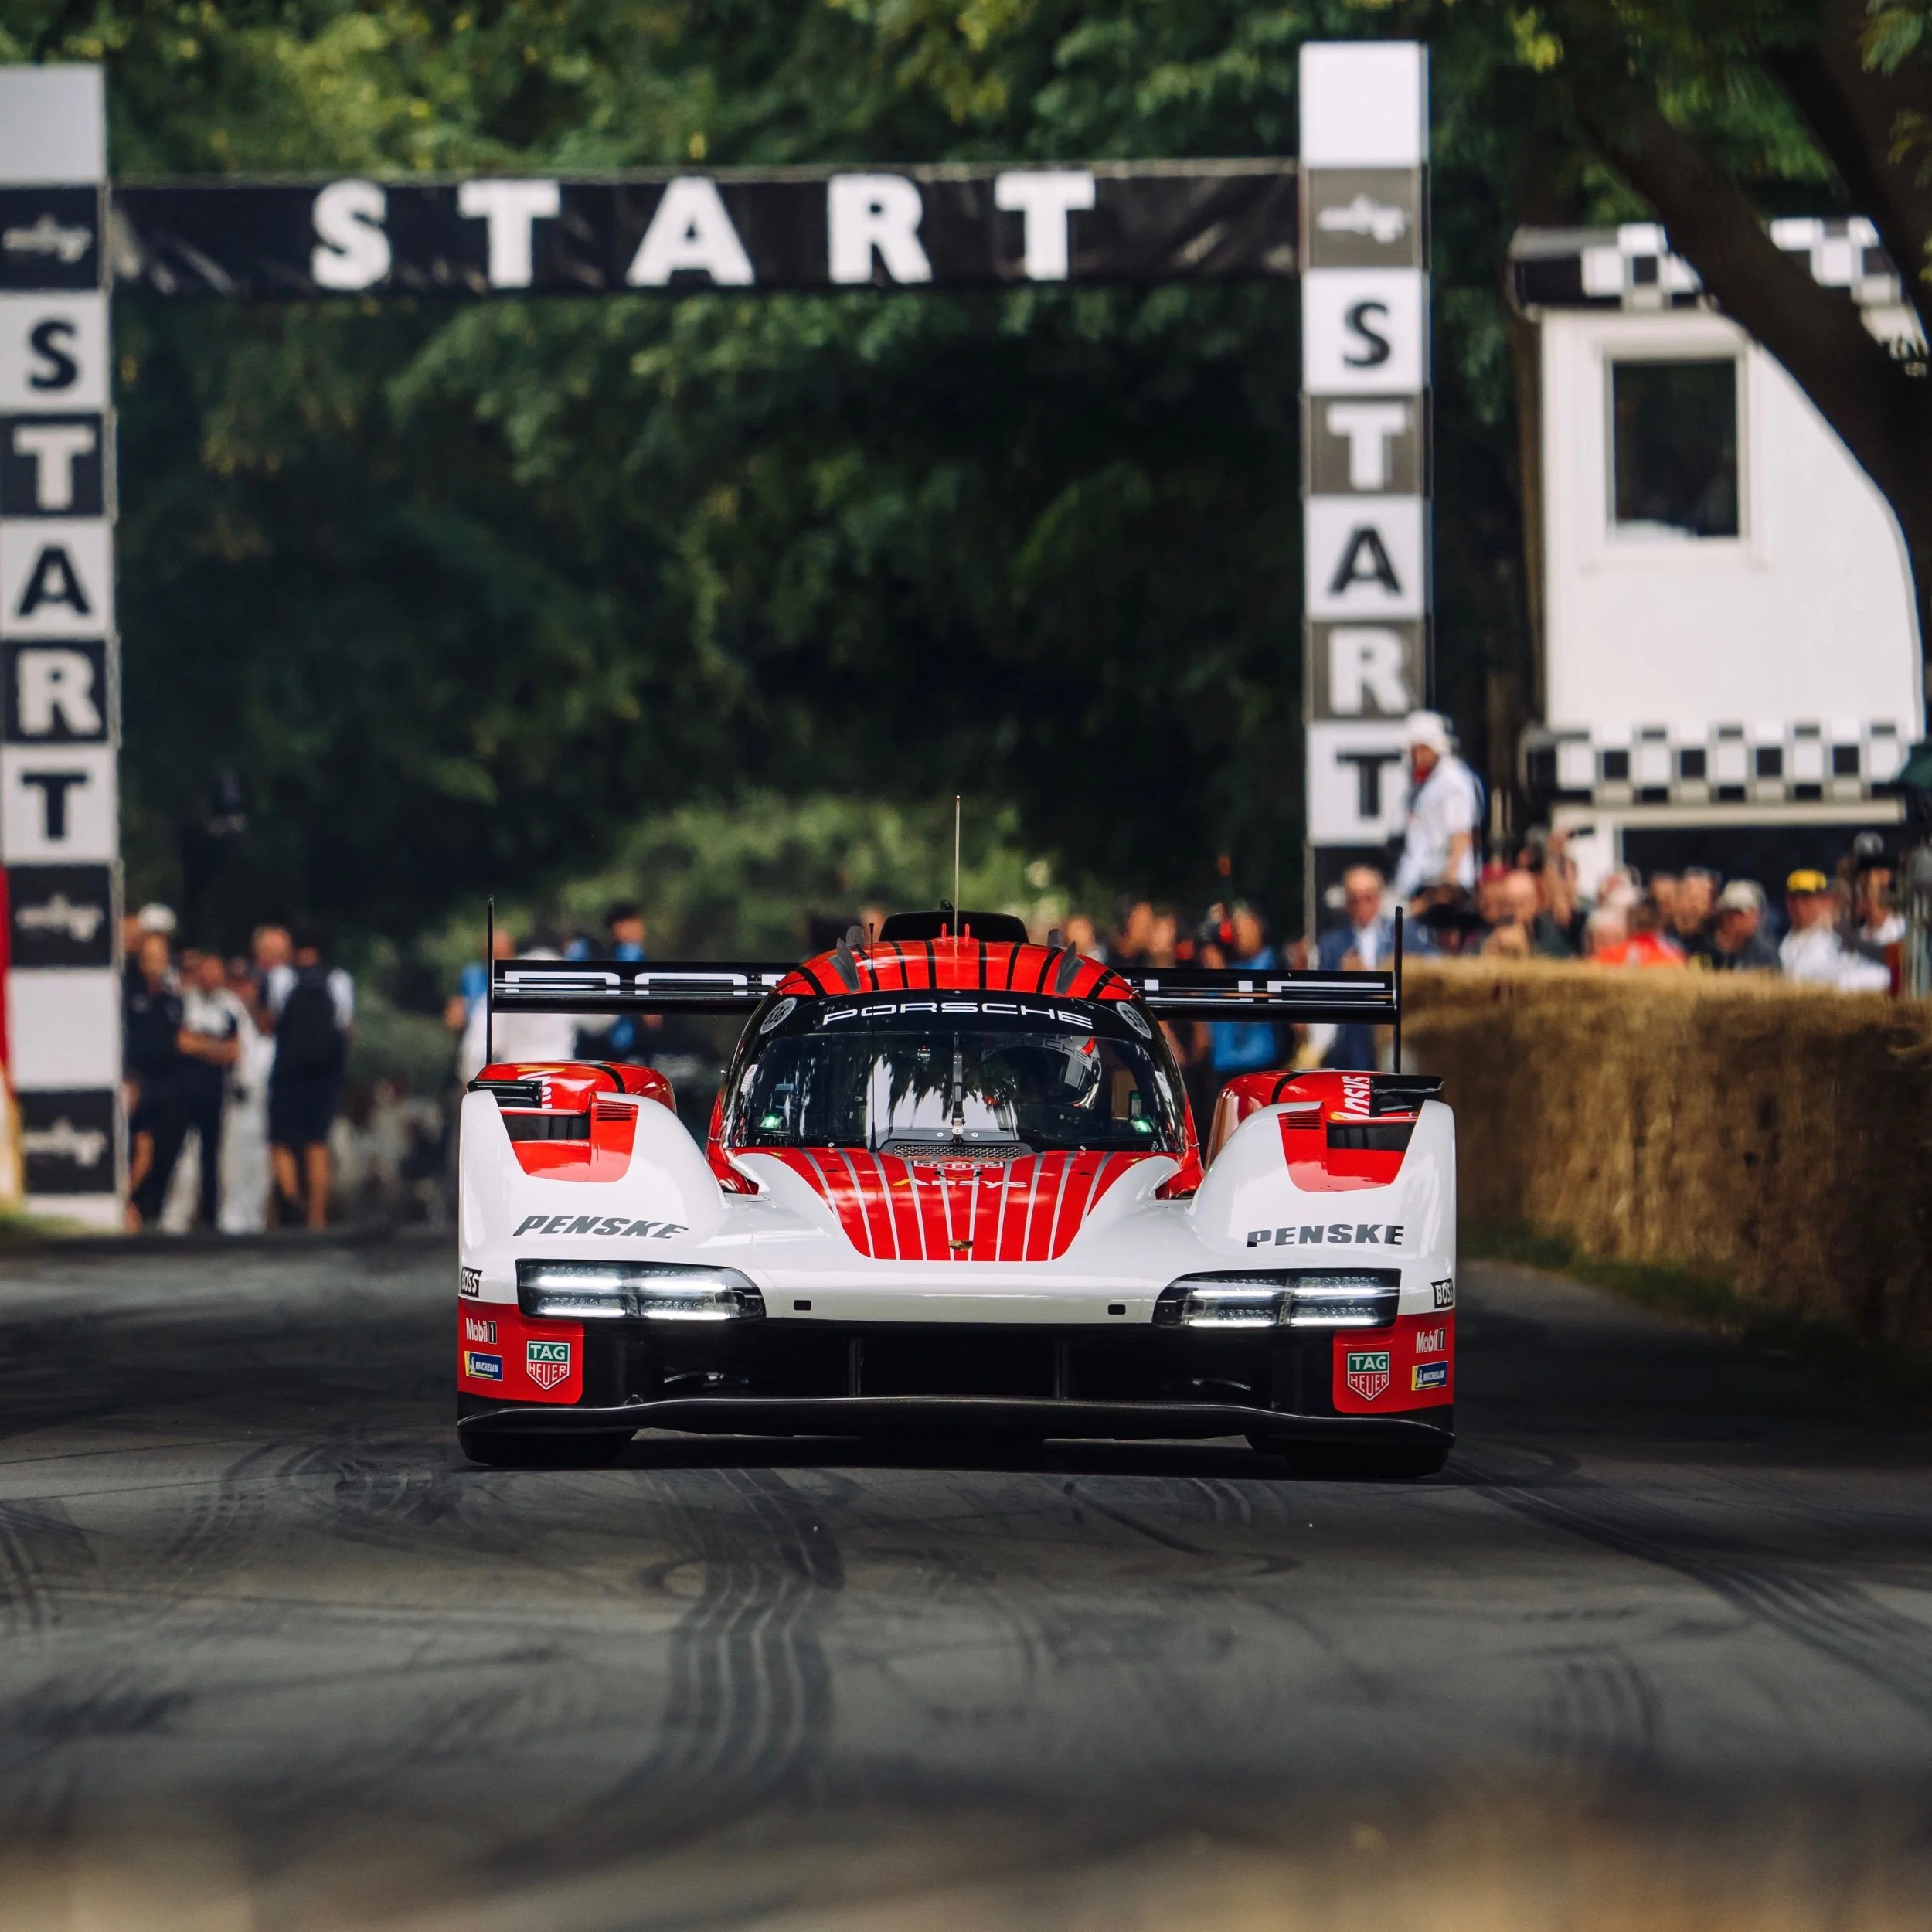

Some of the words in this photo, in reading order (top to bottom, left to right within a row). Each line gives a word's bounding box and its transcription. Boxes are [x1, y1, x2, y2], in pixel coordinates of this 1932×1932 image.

[311, 172, 1095, 291] START
[1326, 301, 1410, 818] START
[13, 320, 102, 841] START
[822, 1002, 1094, 1029] PORSCHE
[891, 1179, 1028, 1189] Ansys
[512, 1215, 689, 1240] PENSKE
[1247, 1223, 1405, 1248] PENSKE
[466, 1318, 488, 1343] Mobil
[1416, 1329, 1439, 1354] Mobil
[529, 1345, 566, 1360] TAG
[1352, 1355, 1386, 1370] TAG
[475, 1360, 498, 1373] MICHELIN
[529, 1362, 566, 1386] HEUER
[1351, 1373, 1387, 1396] HEUER
